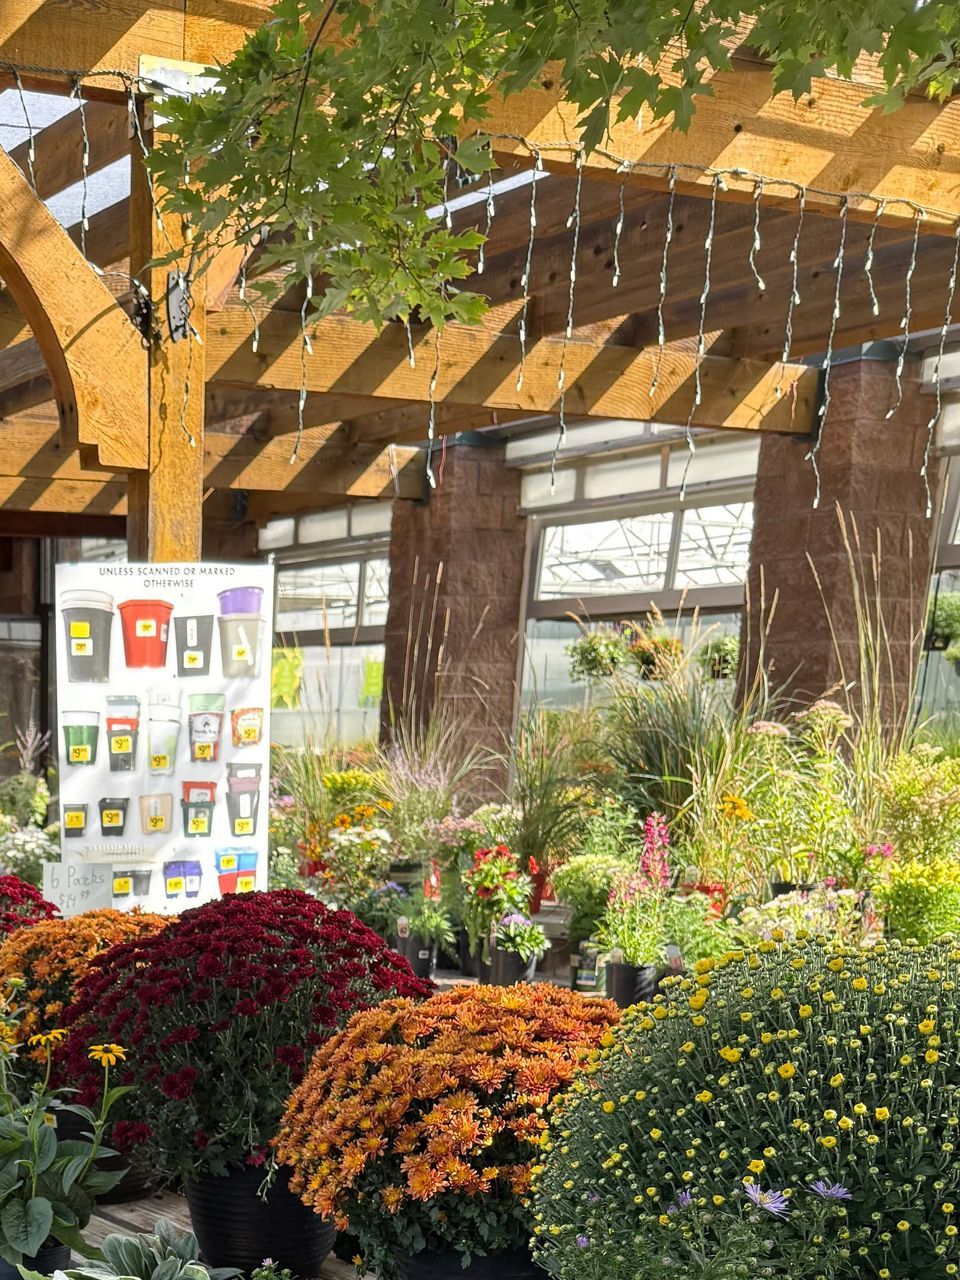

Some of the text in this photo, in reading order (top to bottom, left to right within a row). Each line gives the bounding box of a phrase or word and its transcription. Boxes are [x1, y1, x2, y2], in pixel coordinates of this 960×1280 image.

[99, 567, 236, 576] UNLESS SCANNED OR MARKED
[143, 579, 194, 588] OTHERWISE
[51, 865, 105, 889] 6 Packs
